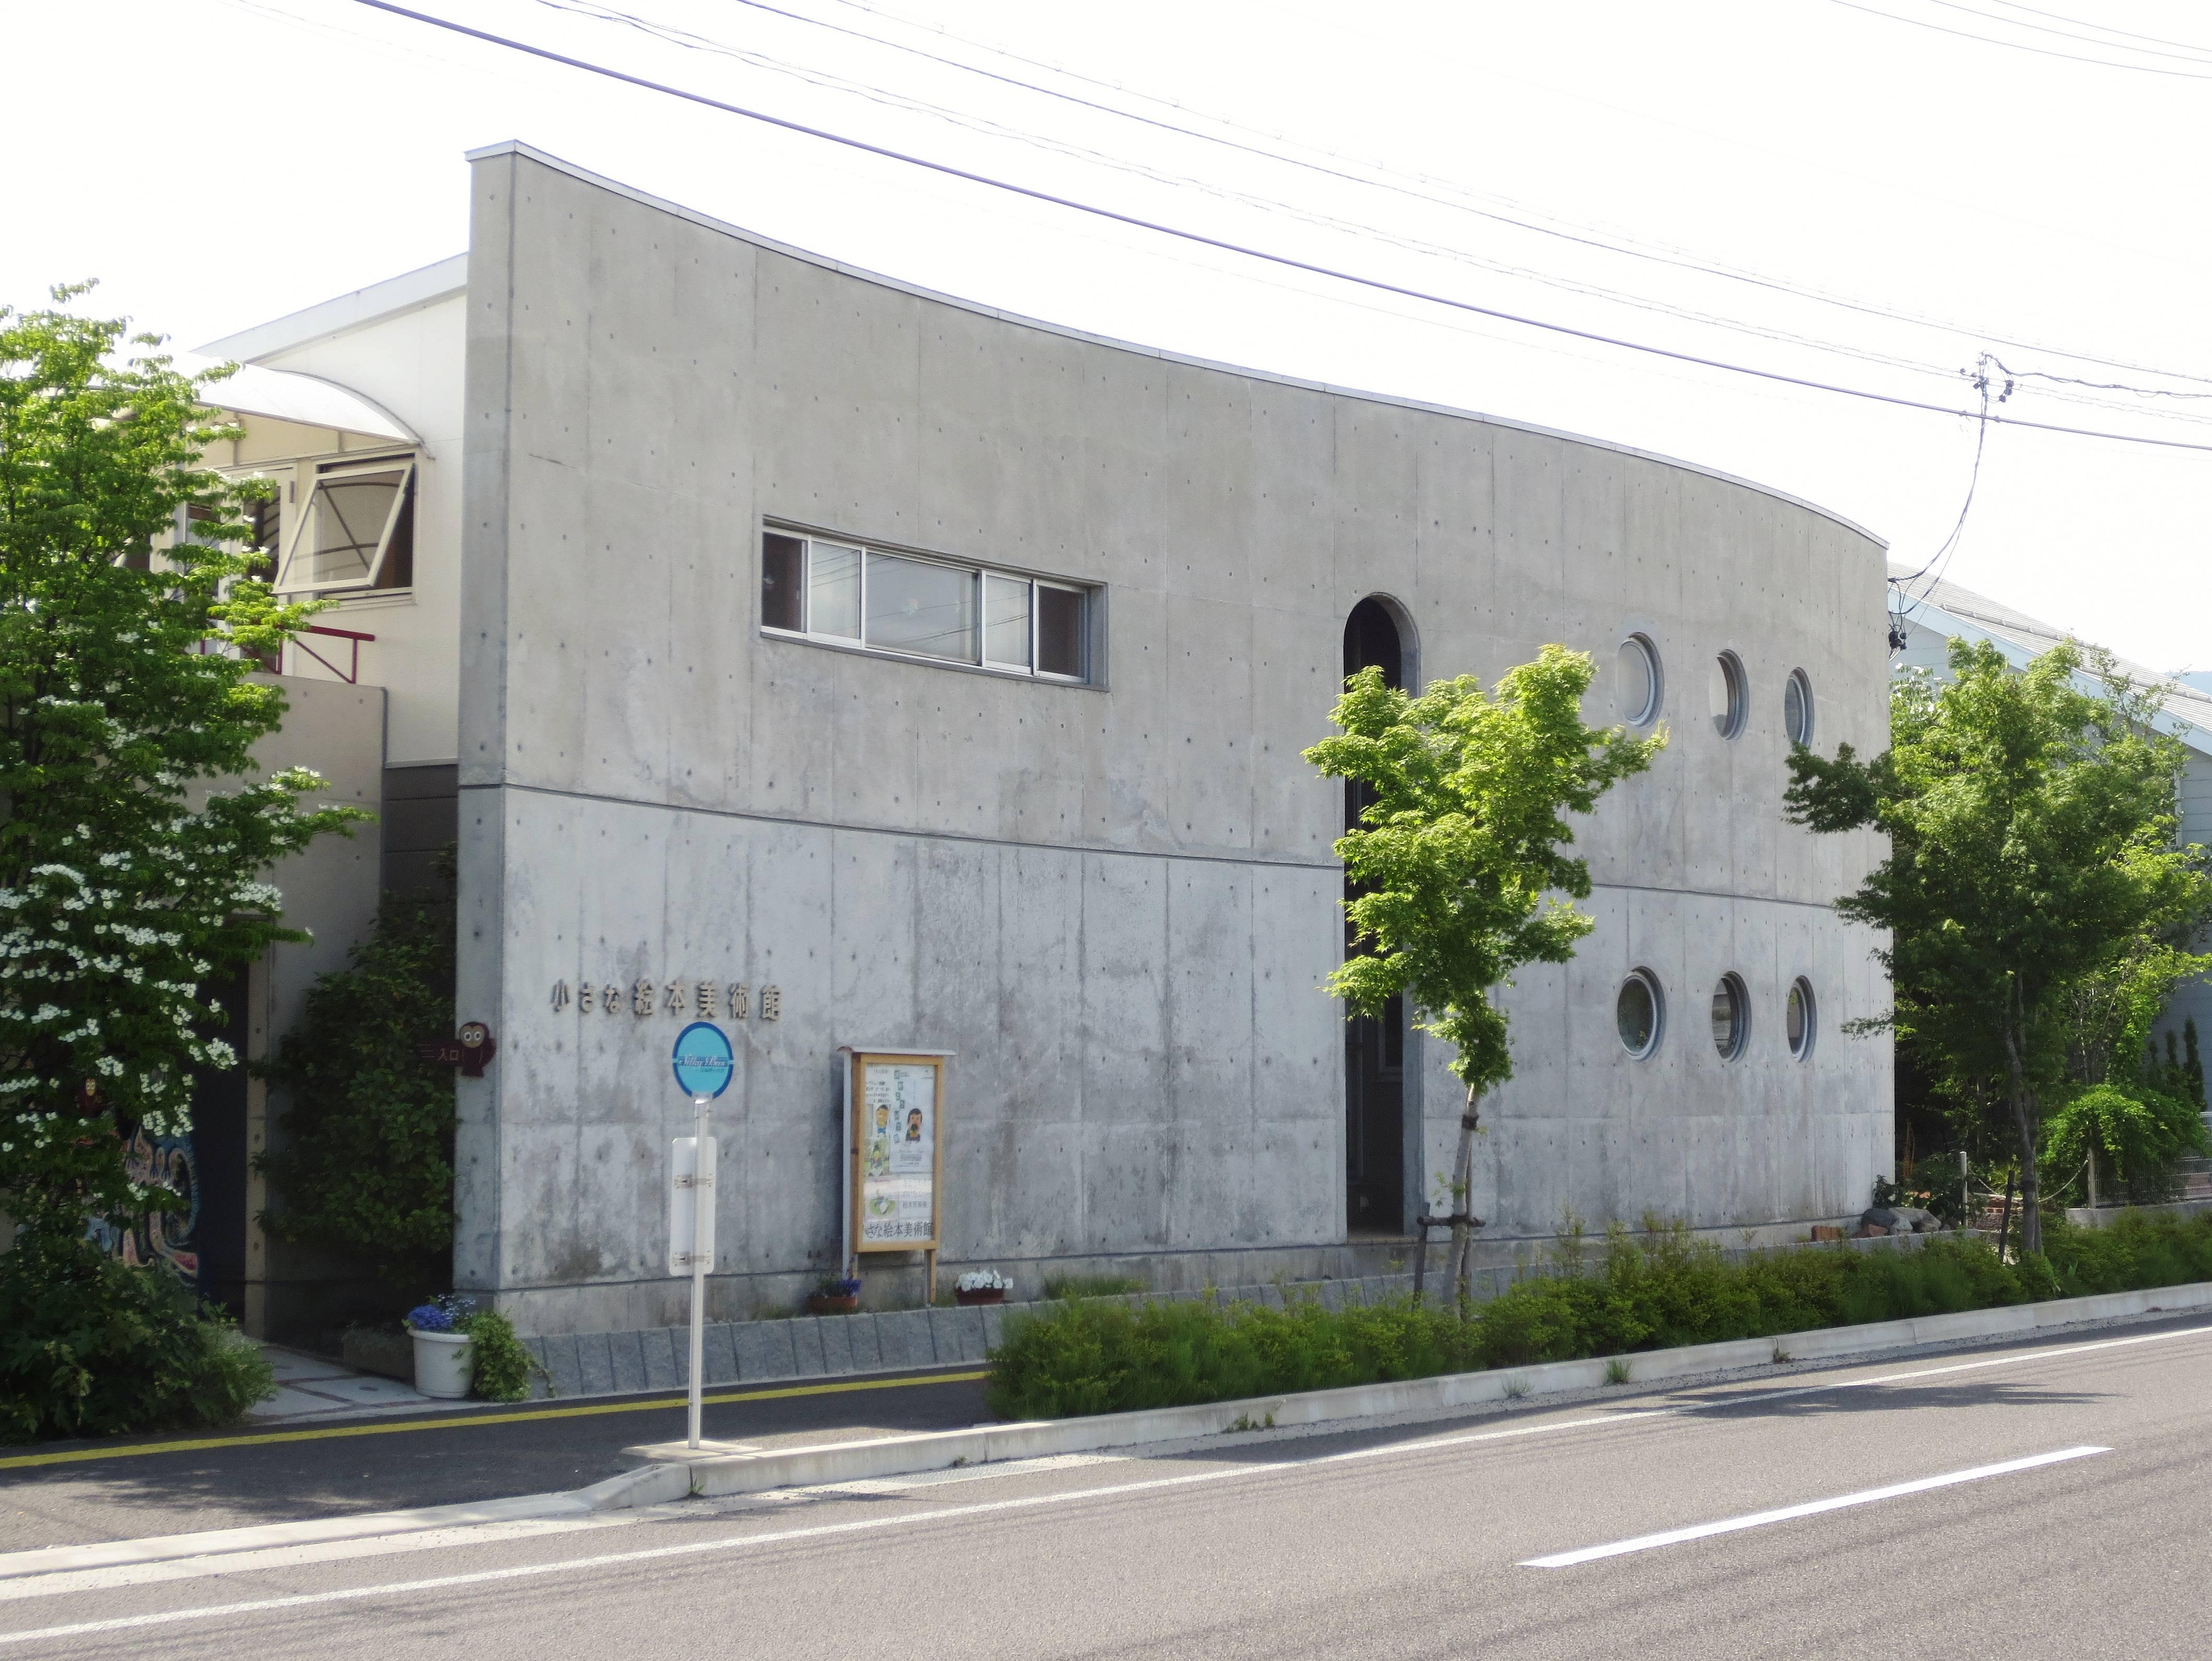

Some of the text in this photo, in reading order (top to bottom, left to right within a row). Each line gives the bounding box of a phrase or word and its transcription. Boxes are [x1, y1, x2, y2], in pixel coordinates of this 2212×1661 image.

[551, 978, 780, 1021] 小さな絵本美術館
[437, 1048, 459, 1061] 入口
